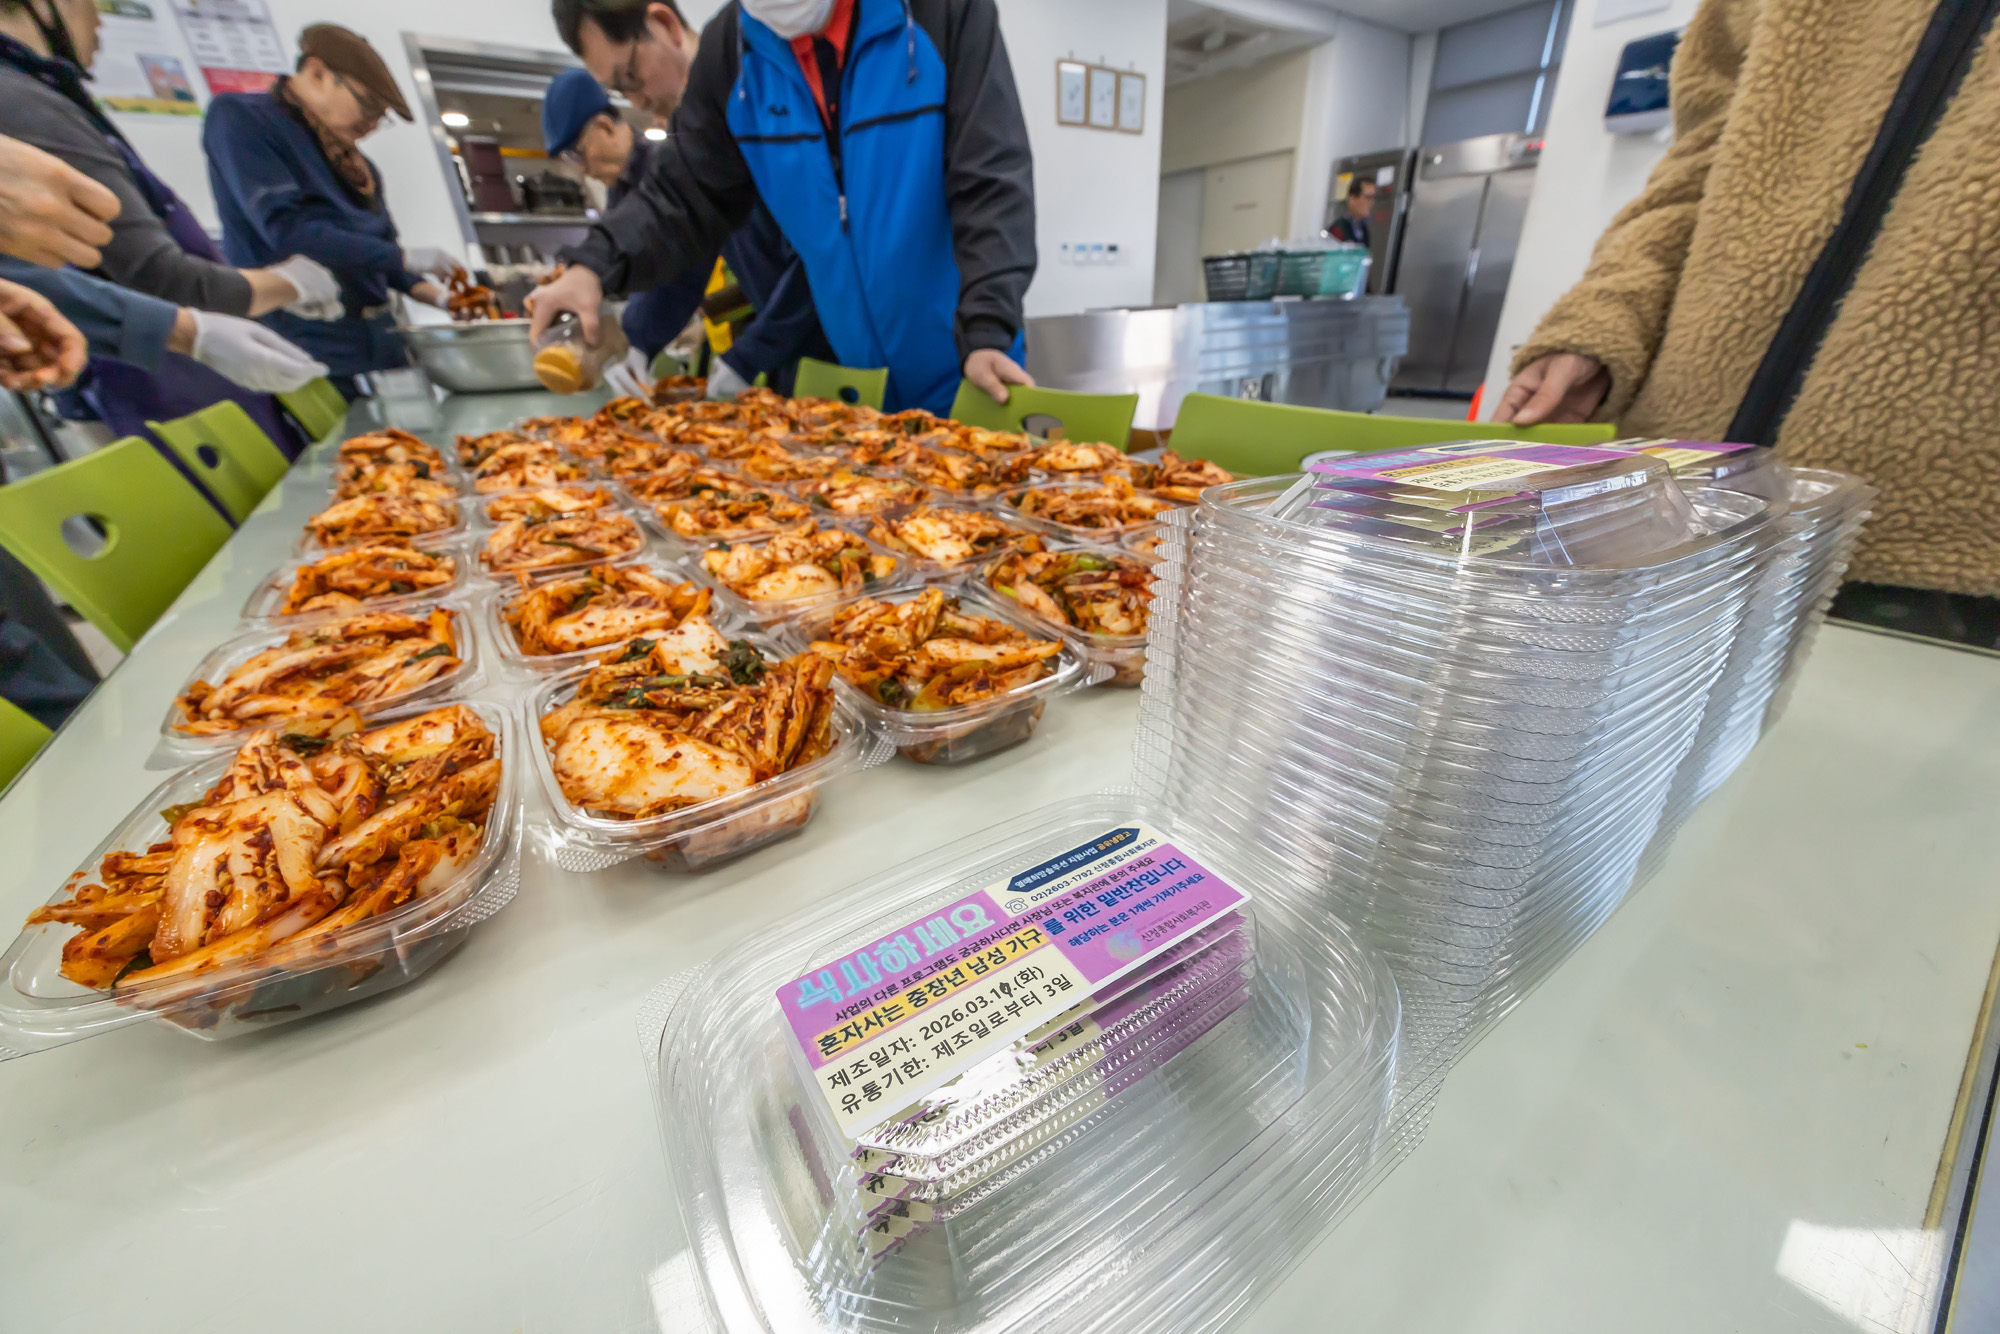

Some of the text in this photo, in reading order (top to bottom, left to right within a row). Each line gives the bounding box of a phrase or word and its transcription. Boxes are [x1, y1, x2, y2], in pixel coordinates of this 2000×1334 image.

[1031, 837, 1158, 901] 02)2603-1792 신정종합사회복지관
[836, 857, 1156, 1021] 사업의 다른 프로그램도 궁금하시다면 사장님 또는 복지관에 문의 주세요
[1067, 923, 1110, 947] 해당하는
[1108, 912, 1130, 927] 분은
[1128, 898, 1155, 915] 1개씩
[1141, 900, 1212, 943] 신정종합사회복지관
[817, 1003, 905, 1057] 혼자사는
[906, 967, 968, 1009] 중장년
[966, 947, 1007, 976] 남성
[1063, 901, 1101, 924] 위한
[1096, 857, 1187, 907] 밑반찬입니다
[827, 1036, 917, 1090] 제조일자:
[841, 973, 1074, 1115] 유통기한: 제조일로부터 3일
